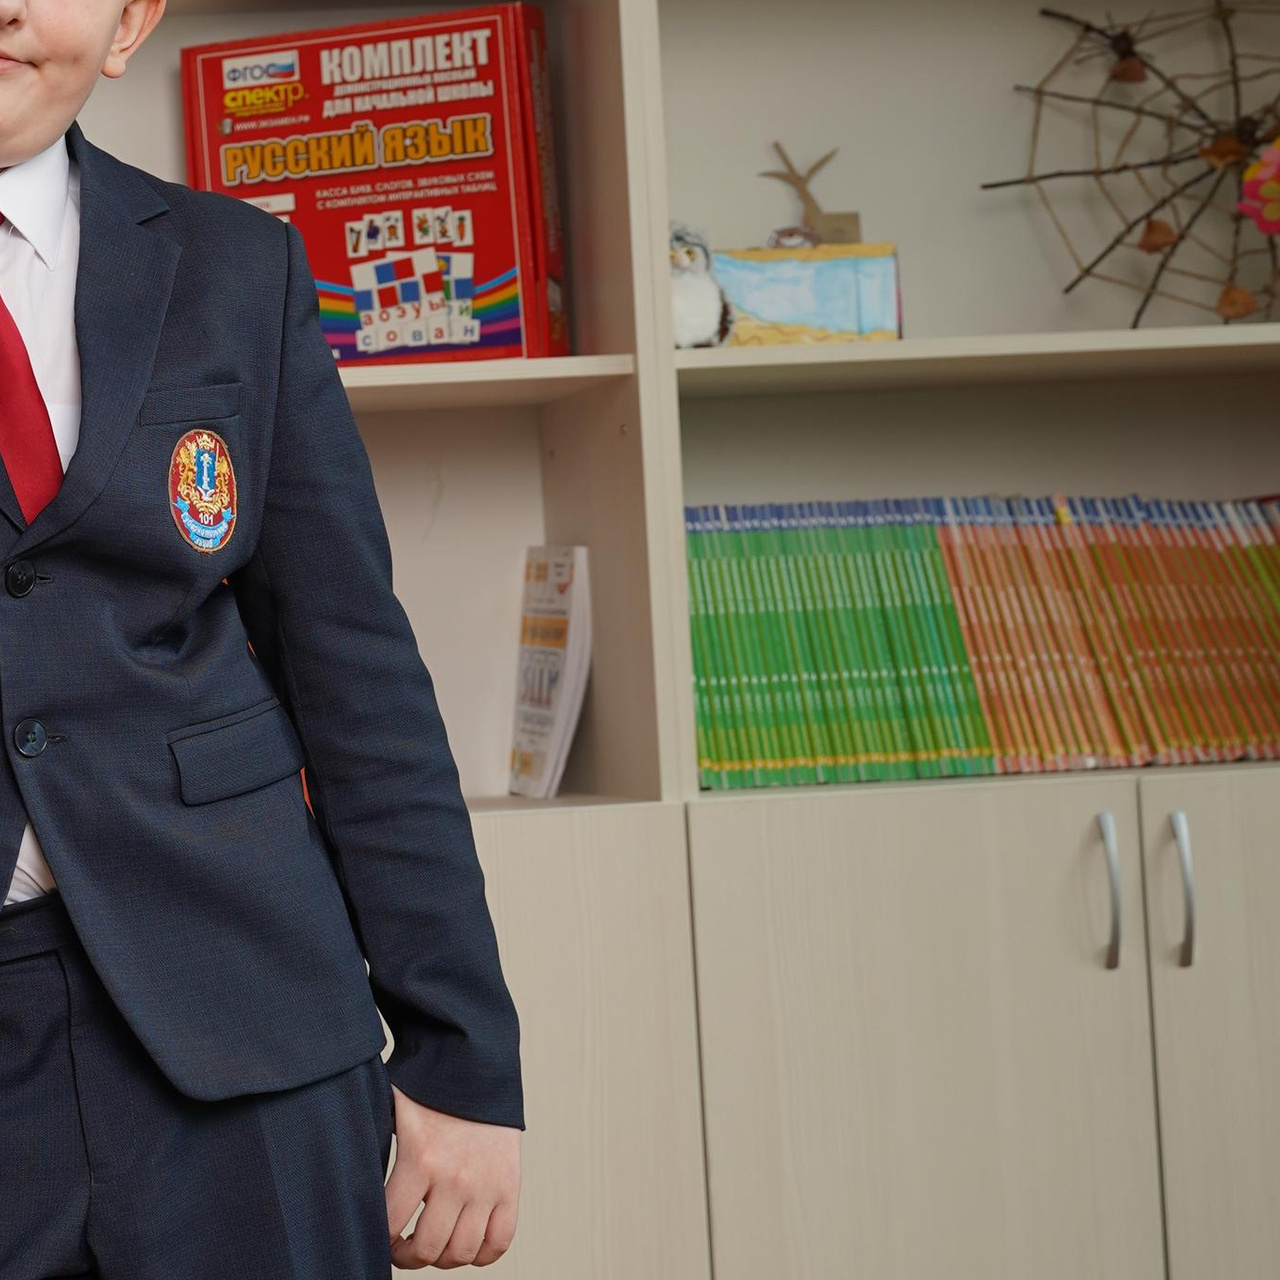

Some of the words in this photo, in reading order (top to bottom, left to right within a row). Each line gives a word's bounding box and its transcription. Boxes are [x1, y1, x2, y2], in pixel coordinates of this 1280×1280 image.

[320, 28, 492, 85] КОМПЛЕКТ
[322, 98, 352, 119] ДЛЯ
[353, 85, 434, 113] НАЧАЛЬНОЙ
[437, 80, 494, 103] ШКОЛЫ
[222, 122, 377, 184] РУССКИЙ
[381, 115, 492, 165] ЯЗЫК
[199, 512, 213, 525] 101
